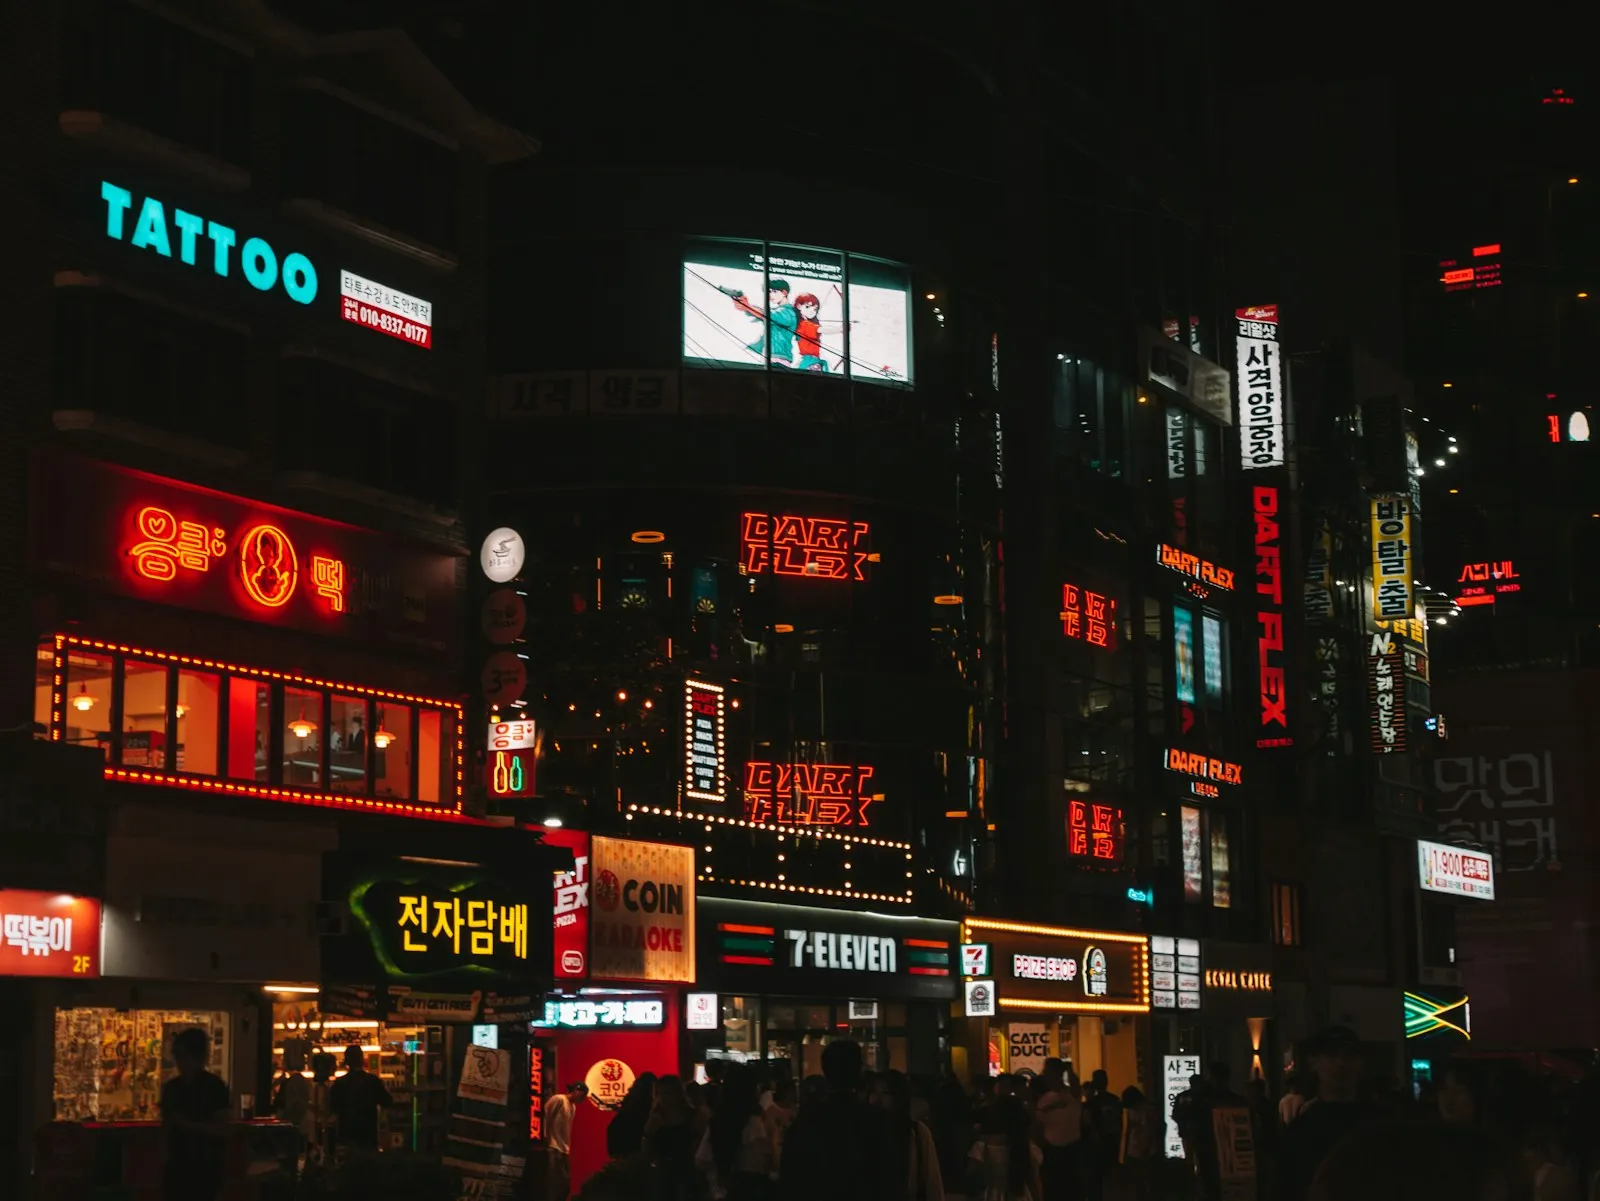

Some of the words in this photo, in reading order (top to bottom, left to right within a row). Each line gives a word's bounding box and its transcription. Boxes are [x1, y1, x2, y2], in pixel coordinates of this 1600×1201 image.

[101, 181, 319, 306] TATTOO
[360, 306, 428, 344] 010-8337-0177
[1239, 321, 1276, 340] 리얼샷
[1246, 344, 1276, 464] 사격양궁장
[743, 513, 869, 549] DART
[1253, 486, 1282, 604] DART
[748, 544, 869, 580] FLEX
[1162, 543, 1200, 577] DART
[1201, 560, 1235, 591] FLEX
[1376, 500, 1408, 616] 방탈출
[314, 556, 343, 612] 떡
[1258, 611, 1287, 728] FLEX
[747, 762, 874, 794] DART
[1169, 748, 1207, 778] DART
[1209, 758, 1242, 784] FLEX
[752, 793, 871, 826] FLEX
[623, 879, 683, 915] COIN
[4, 914, 72, 956] 떡볶이
[398, 896, 528, 959] 전자담배
[594, 921, 682, 952] KARAOKE
[73, 955, 90, 974] 2F
[1013, 953, 1047, 980] PRIZE
[1047, 956, 1078, 981] SHOP
[530, 1047, 543, 1094] DART
[599, 1082, 626, 1097] 코인
[529, 1095, 542, 1141] FLEX
